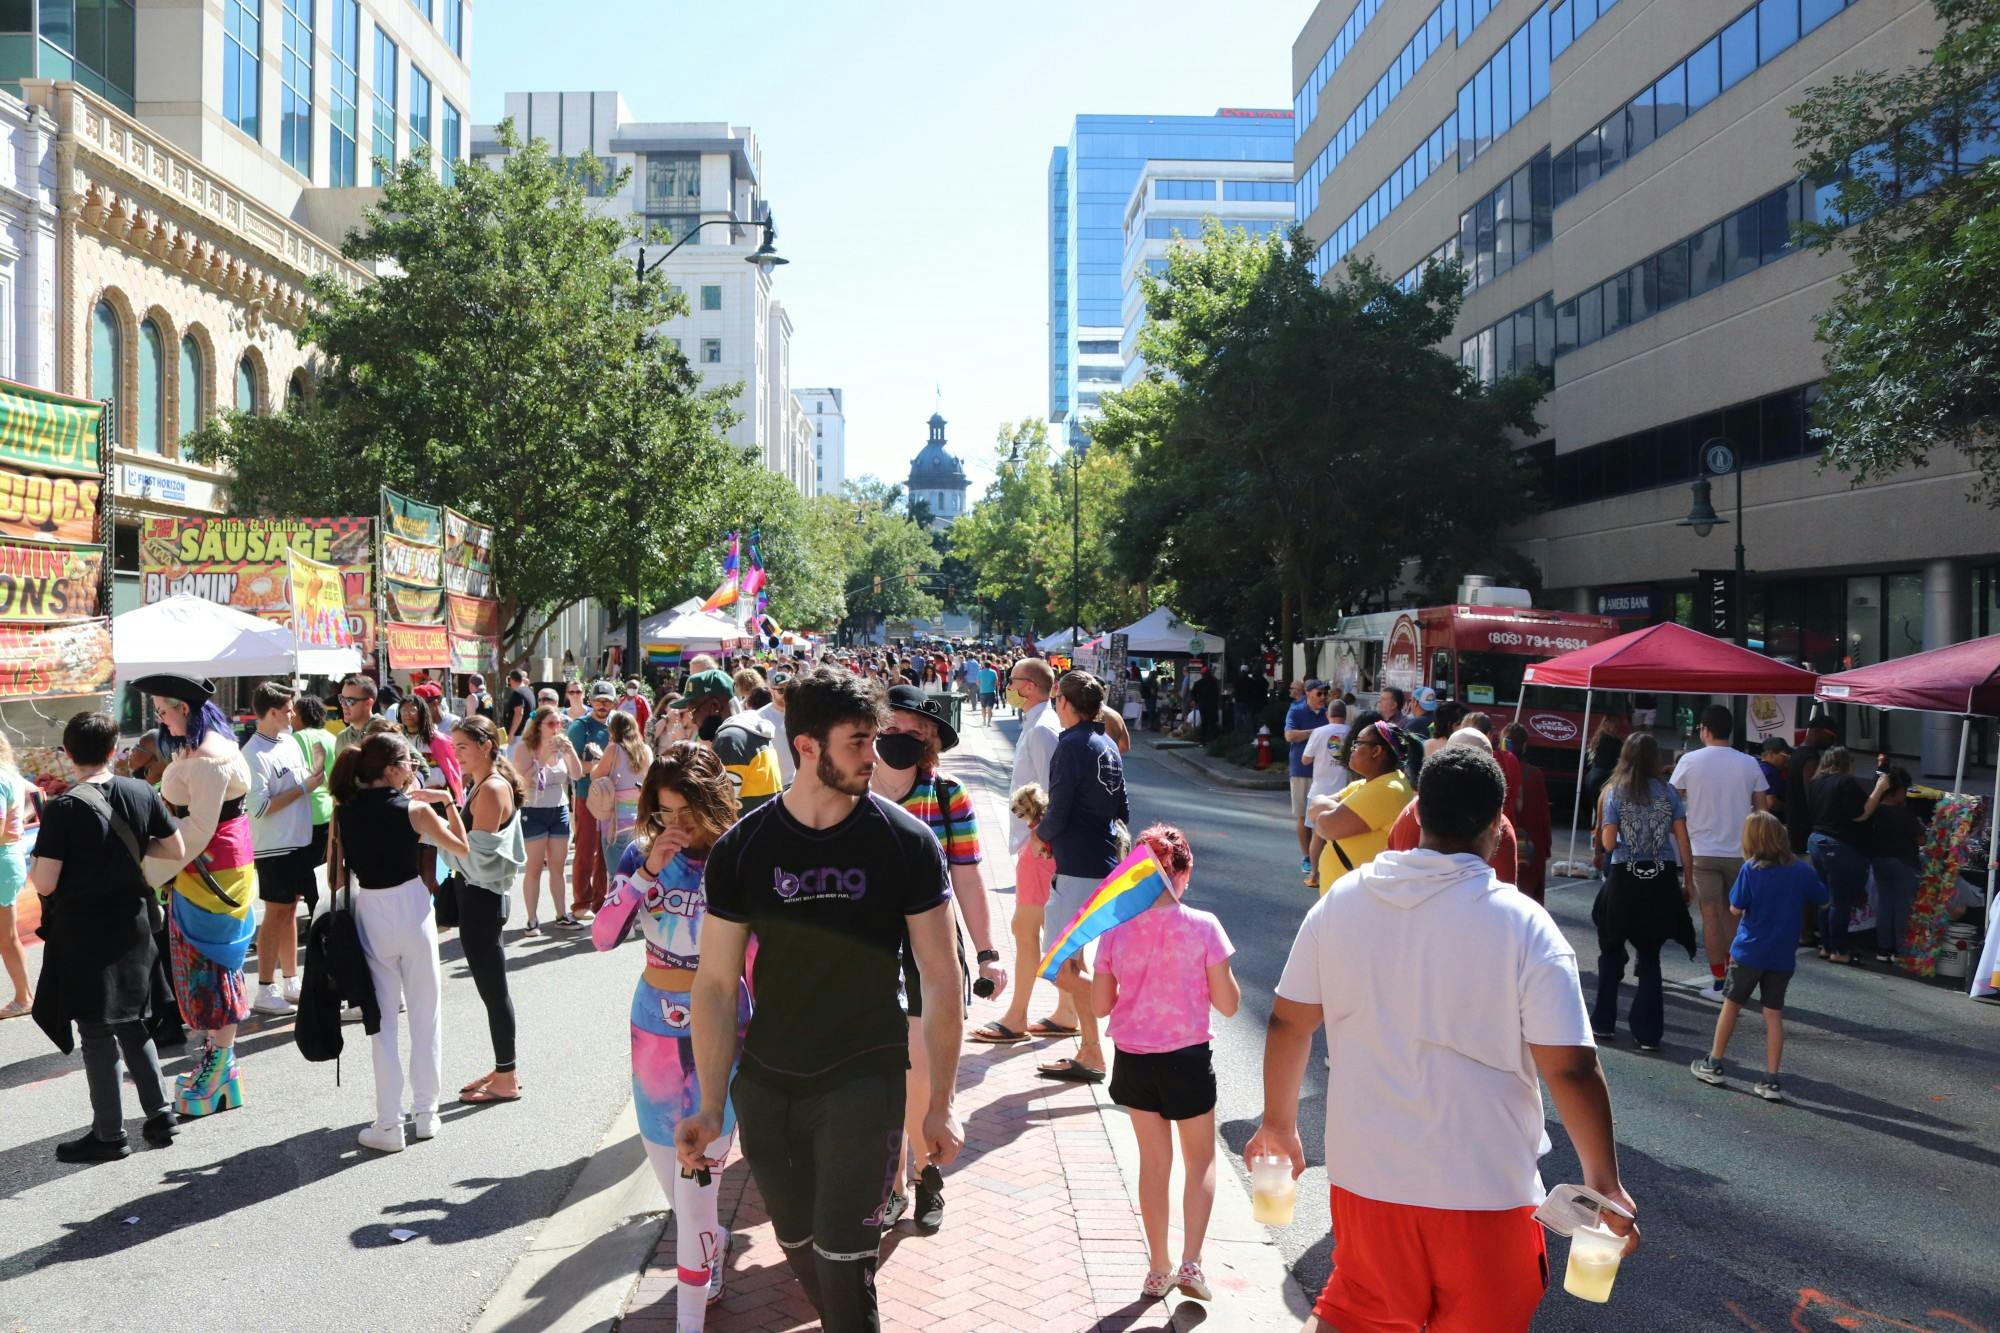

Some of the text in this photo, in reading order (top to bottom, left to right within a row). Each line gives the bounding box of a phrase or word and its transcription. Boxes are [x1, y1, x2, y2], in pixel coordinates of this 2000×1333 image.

[138, 473, 185, 492] FIRST HORIZON
[206, 519, 244, 533] Polish
[264, 519, 306, 533] Italian
[179, 528, 332, 562] SAUSAGE
[1607, 596, 1649, 610] AMERIS BANK
[1488, 632, 1588, 650] (803) 794-6634
[773, 866, 866, 901] bang
